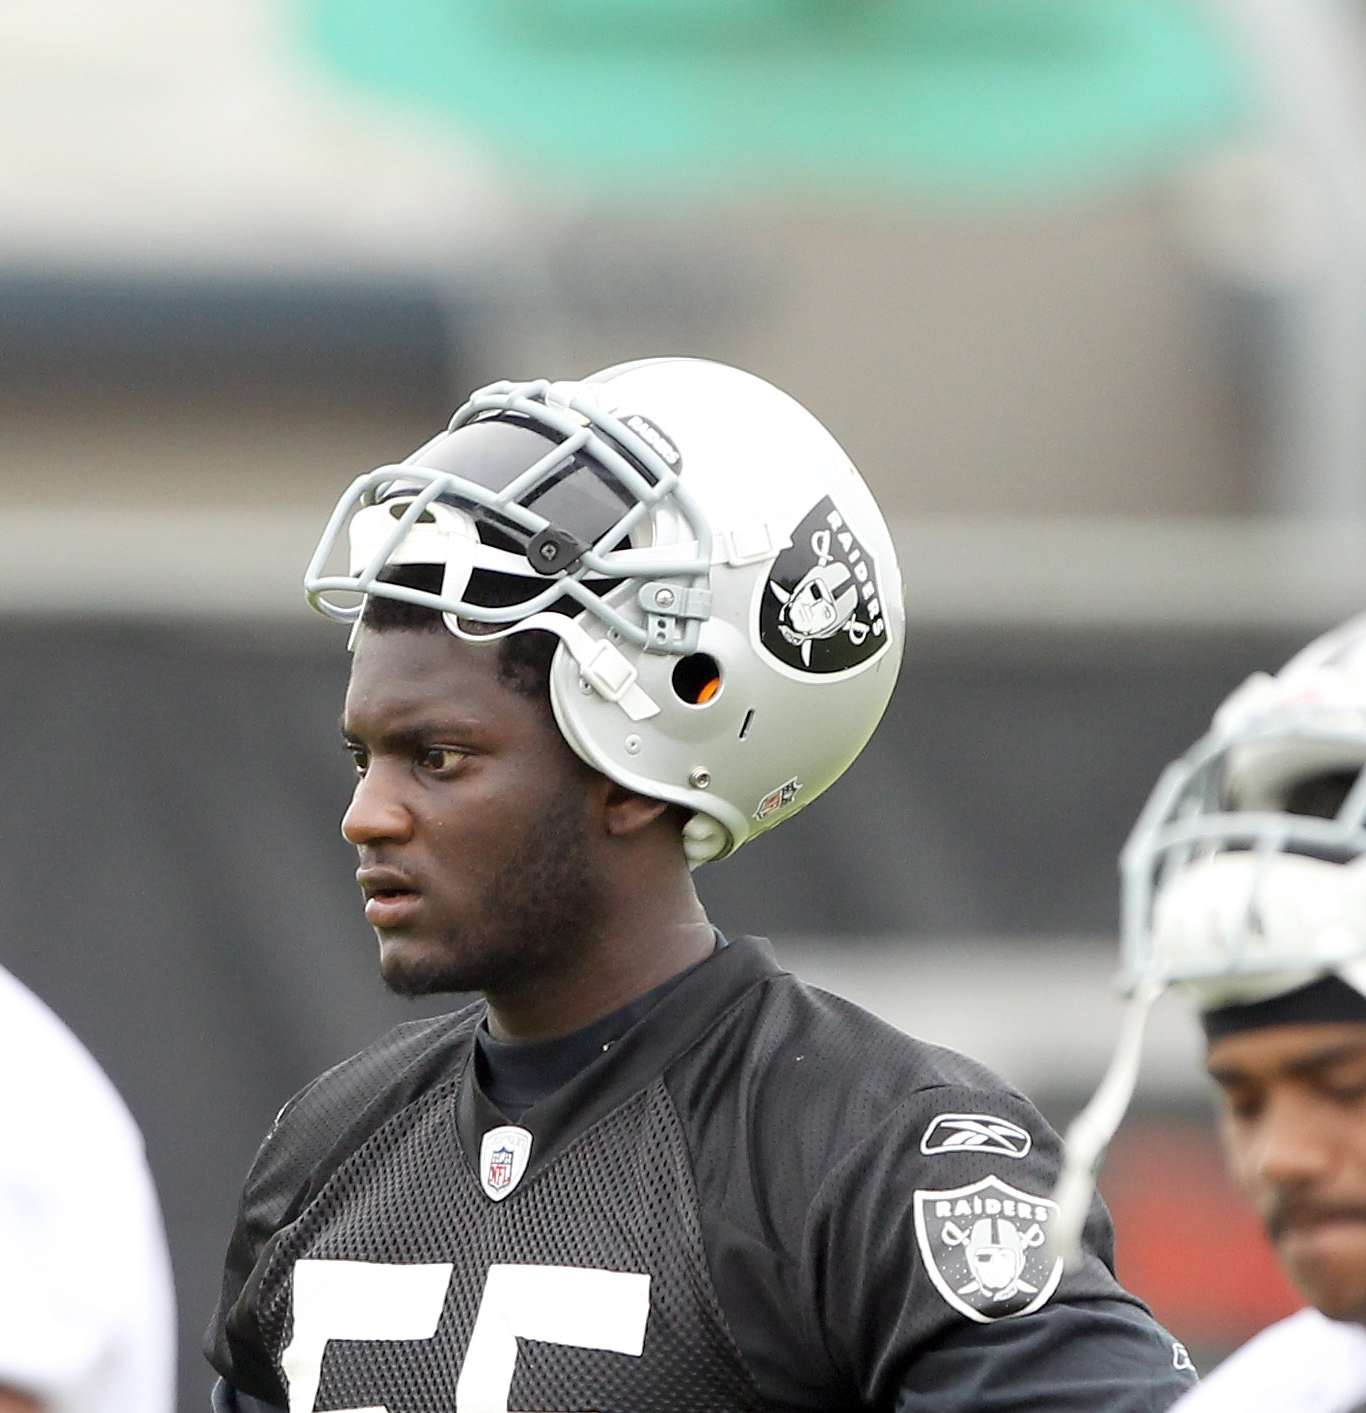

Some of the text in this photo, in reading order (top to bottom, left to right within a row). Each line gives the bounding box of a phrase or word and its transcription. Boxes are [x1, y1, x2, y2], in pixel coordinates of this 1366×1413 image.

[825, 509, 884, 637] RAIDERS
[490, 1165, 511, 1186] NFL
[935, 1195, 1048, 1222] RAIDERS
